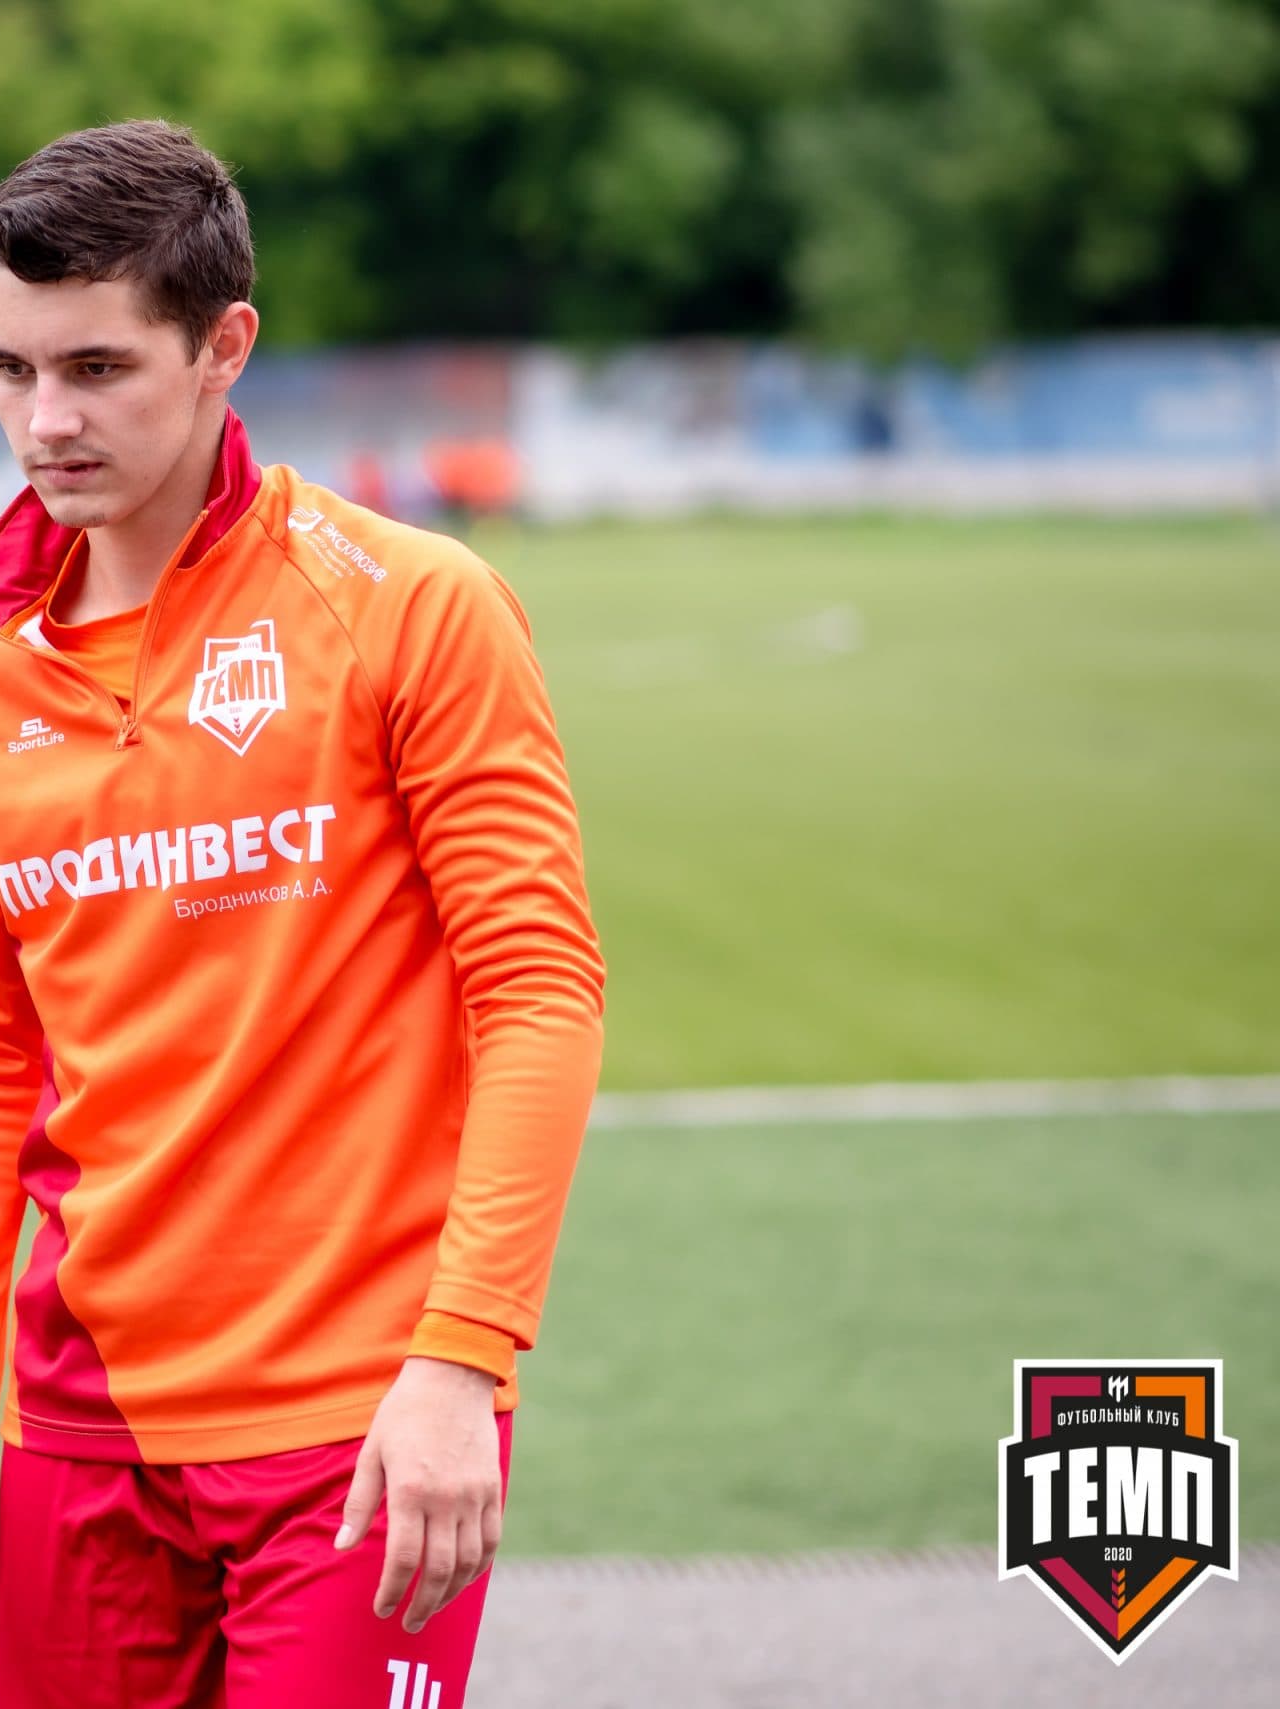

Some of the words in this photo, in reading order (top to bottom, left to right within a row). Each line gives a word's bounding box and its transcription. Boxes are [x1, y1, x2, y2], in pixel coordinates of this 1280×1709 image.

[320, 521, 387, 583] ЭКСКЛЮЗИВ
[200, 659, 278, 712] ТЕМП
[7, 732, 65, 754] SportLife
[20, 717, 51, 738] SL
[174, 886, 289, 919] Бродников
